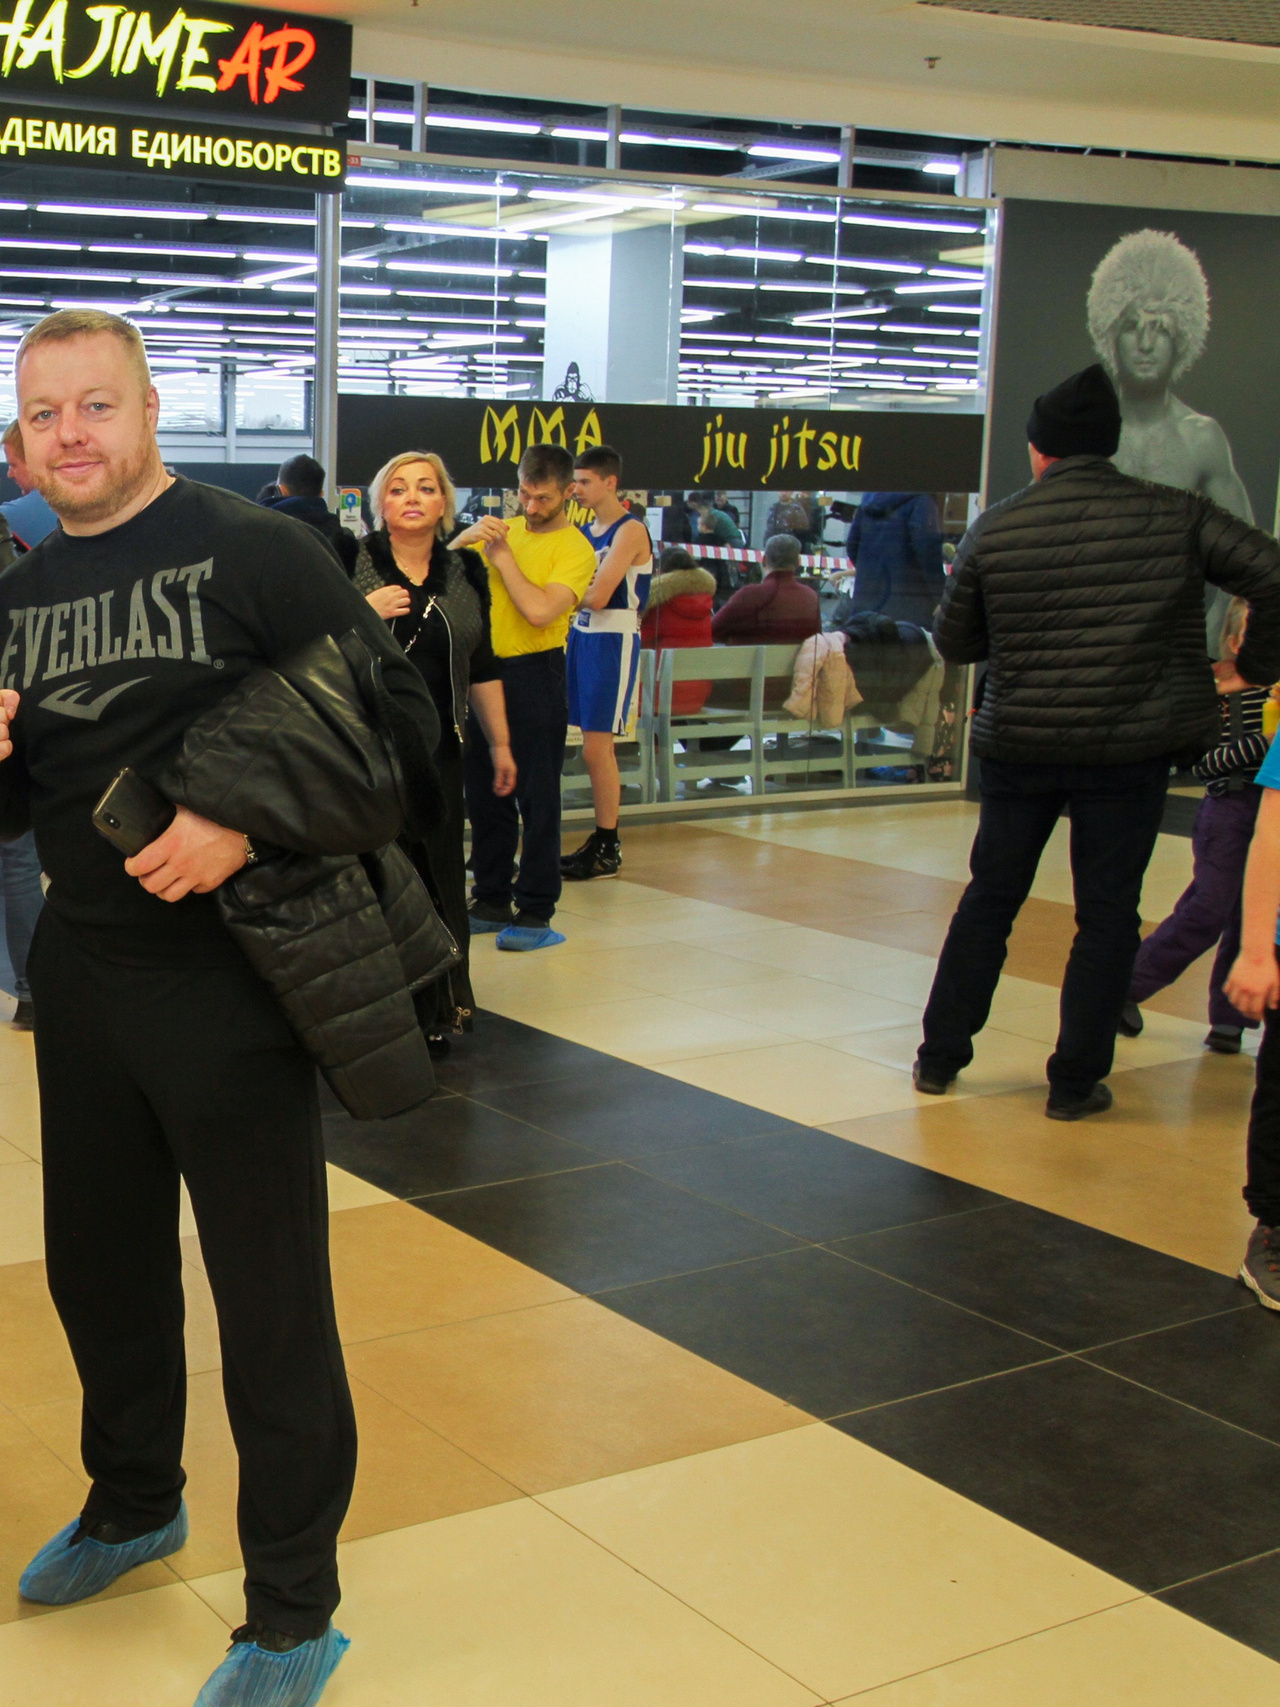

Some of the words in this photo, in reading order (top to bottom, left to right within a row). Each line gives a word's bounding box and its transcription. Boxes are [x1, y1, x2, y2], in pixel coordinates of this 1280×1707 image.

[131, 129, 342, 178] ЕДИНОБОРСТВ
[480, 404, 603, 465] MMA
[693, 413, 748, 484] jiu
[760, 415, 863, 485] jitsu
